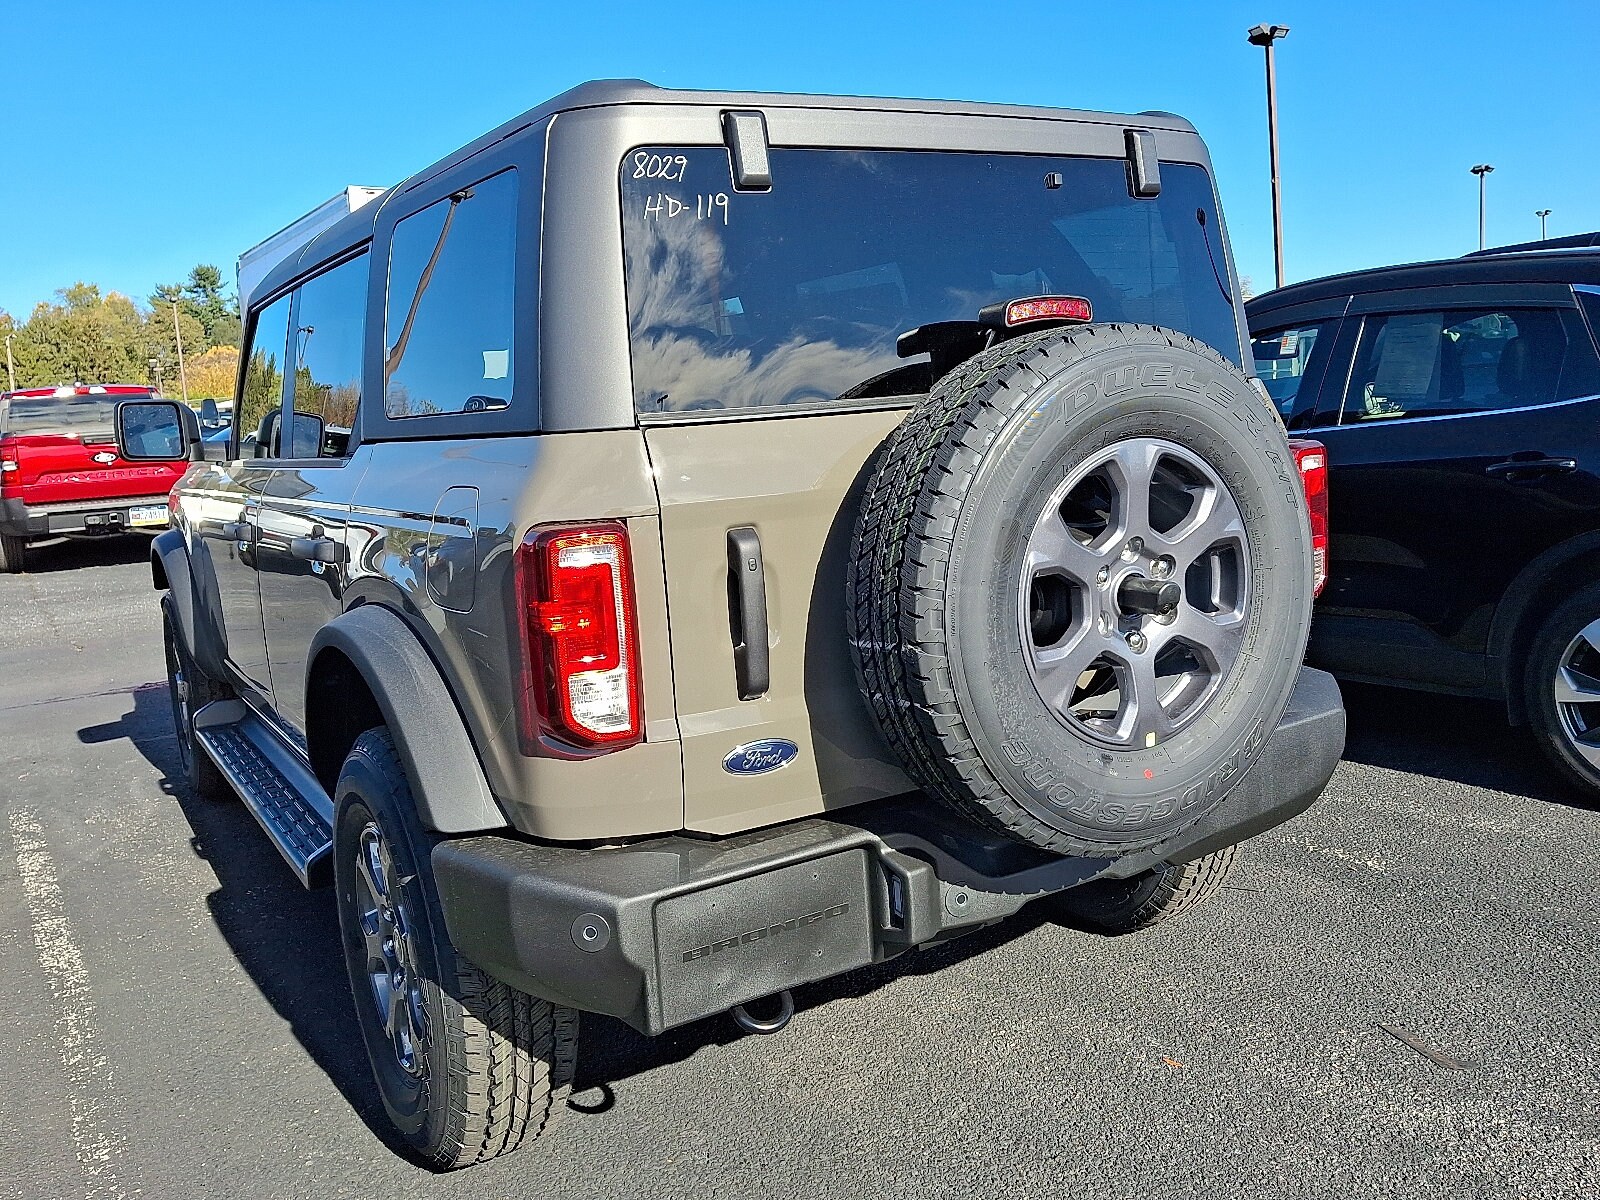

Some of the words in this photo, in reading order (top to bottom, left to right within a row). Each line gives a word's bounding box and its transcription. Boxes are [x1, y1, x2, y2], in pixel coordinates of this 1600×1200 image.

[632, 151, 687, 182] 8029
[643, 192, 728, 225] HD-119
[1063, 363, 1268, 438] DUELER
[45, 466, 165, 484] MAVERICK
[1001, 717, 1264, 827] BRIDGESTONE
[682, 901, 850, 964] BRONCO
